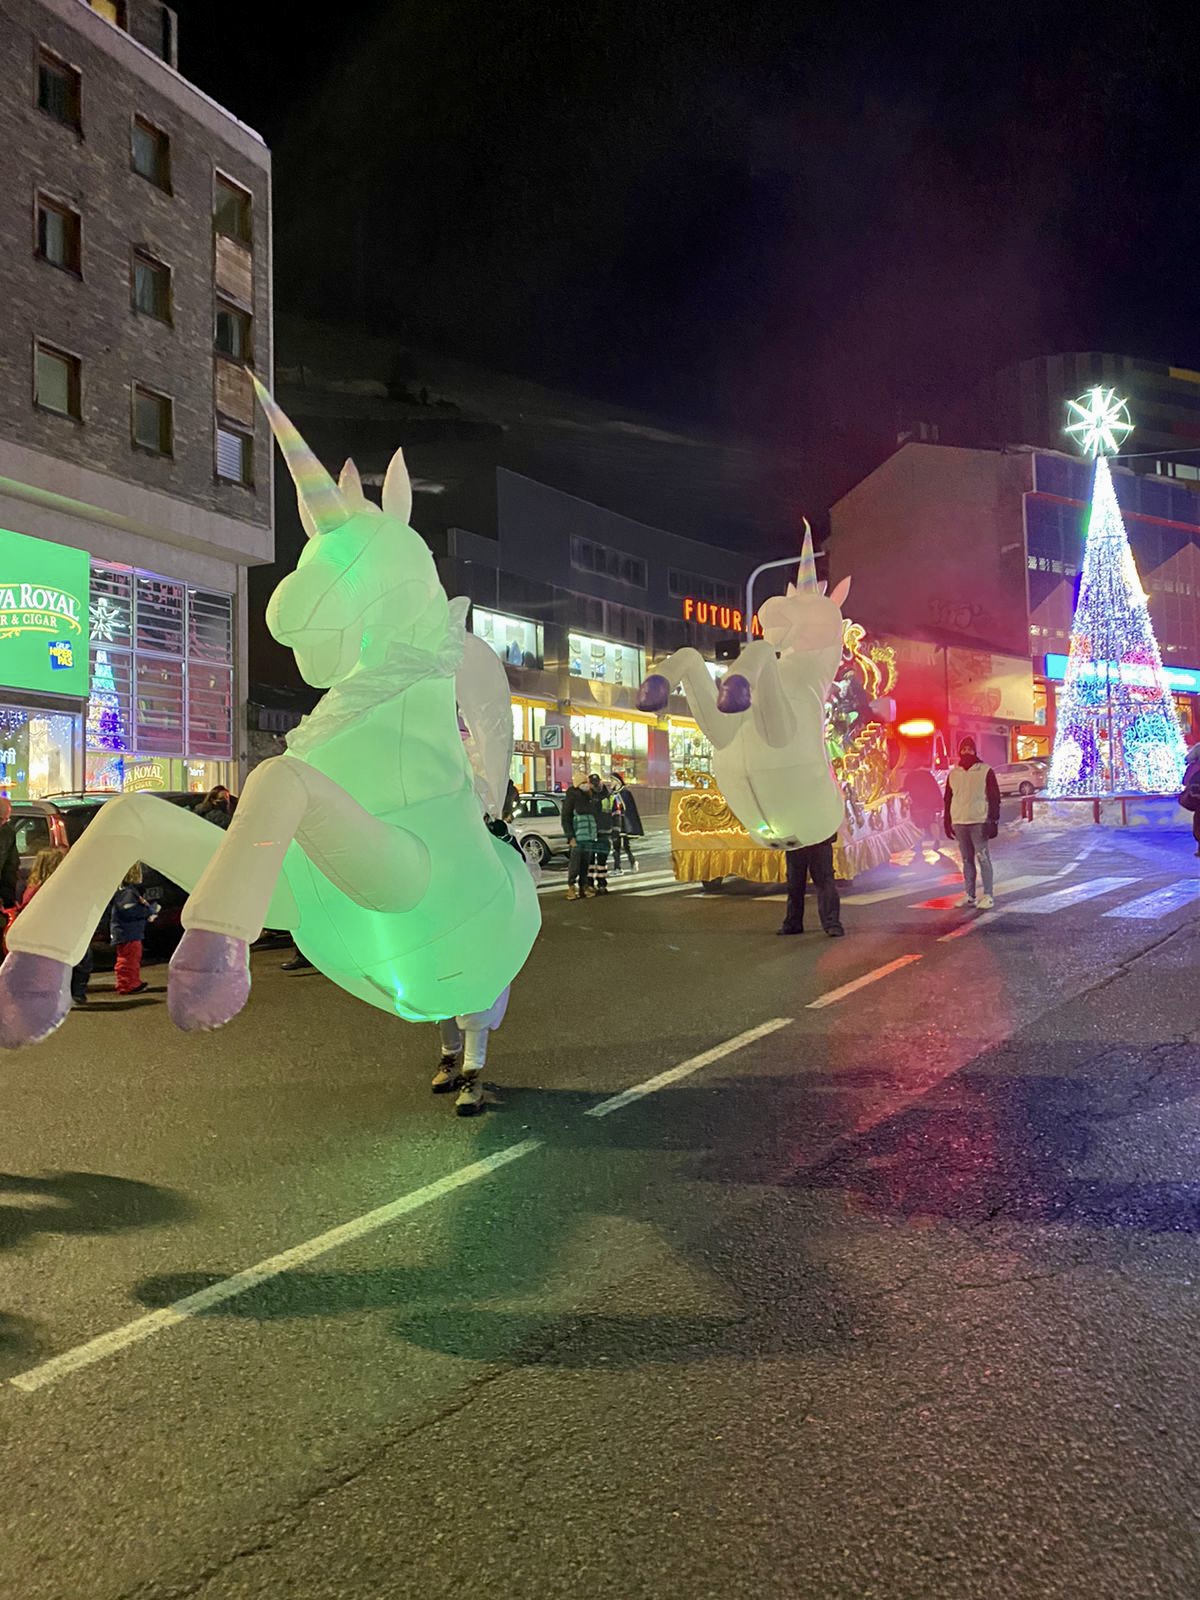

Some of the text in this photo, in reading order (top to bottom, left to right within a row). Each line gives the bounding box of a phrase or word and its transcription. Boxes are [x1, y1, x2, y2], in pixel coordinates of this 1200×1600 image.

[19, 583, 80, 621] ROYAL
[11, 614, 19, 625] &
[22, 613, 58, 628] CIGAR
[134, 765, 163, 780] ROYAL
